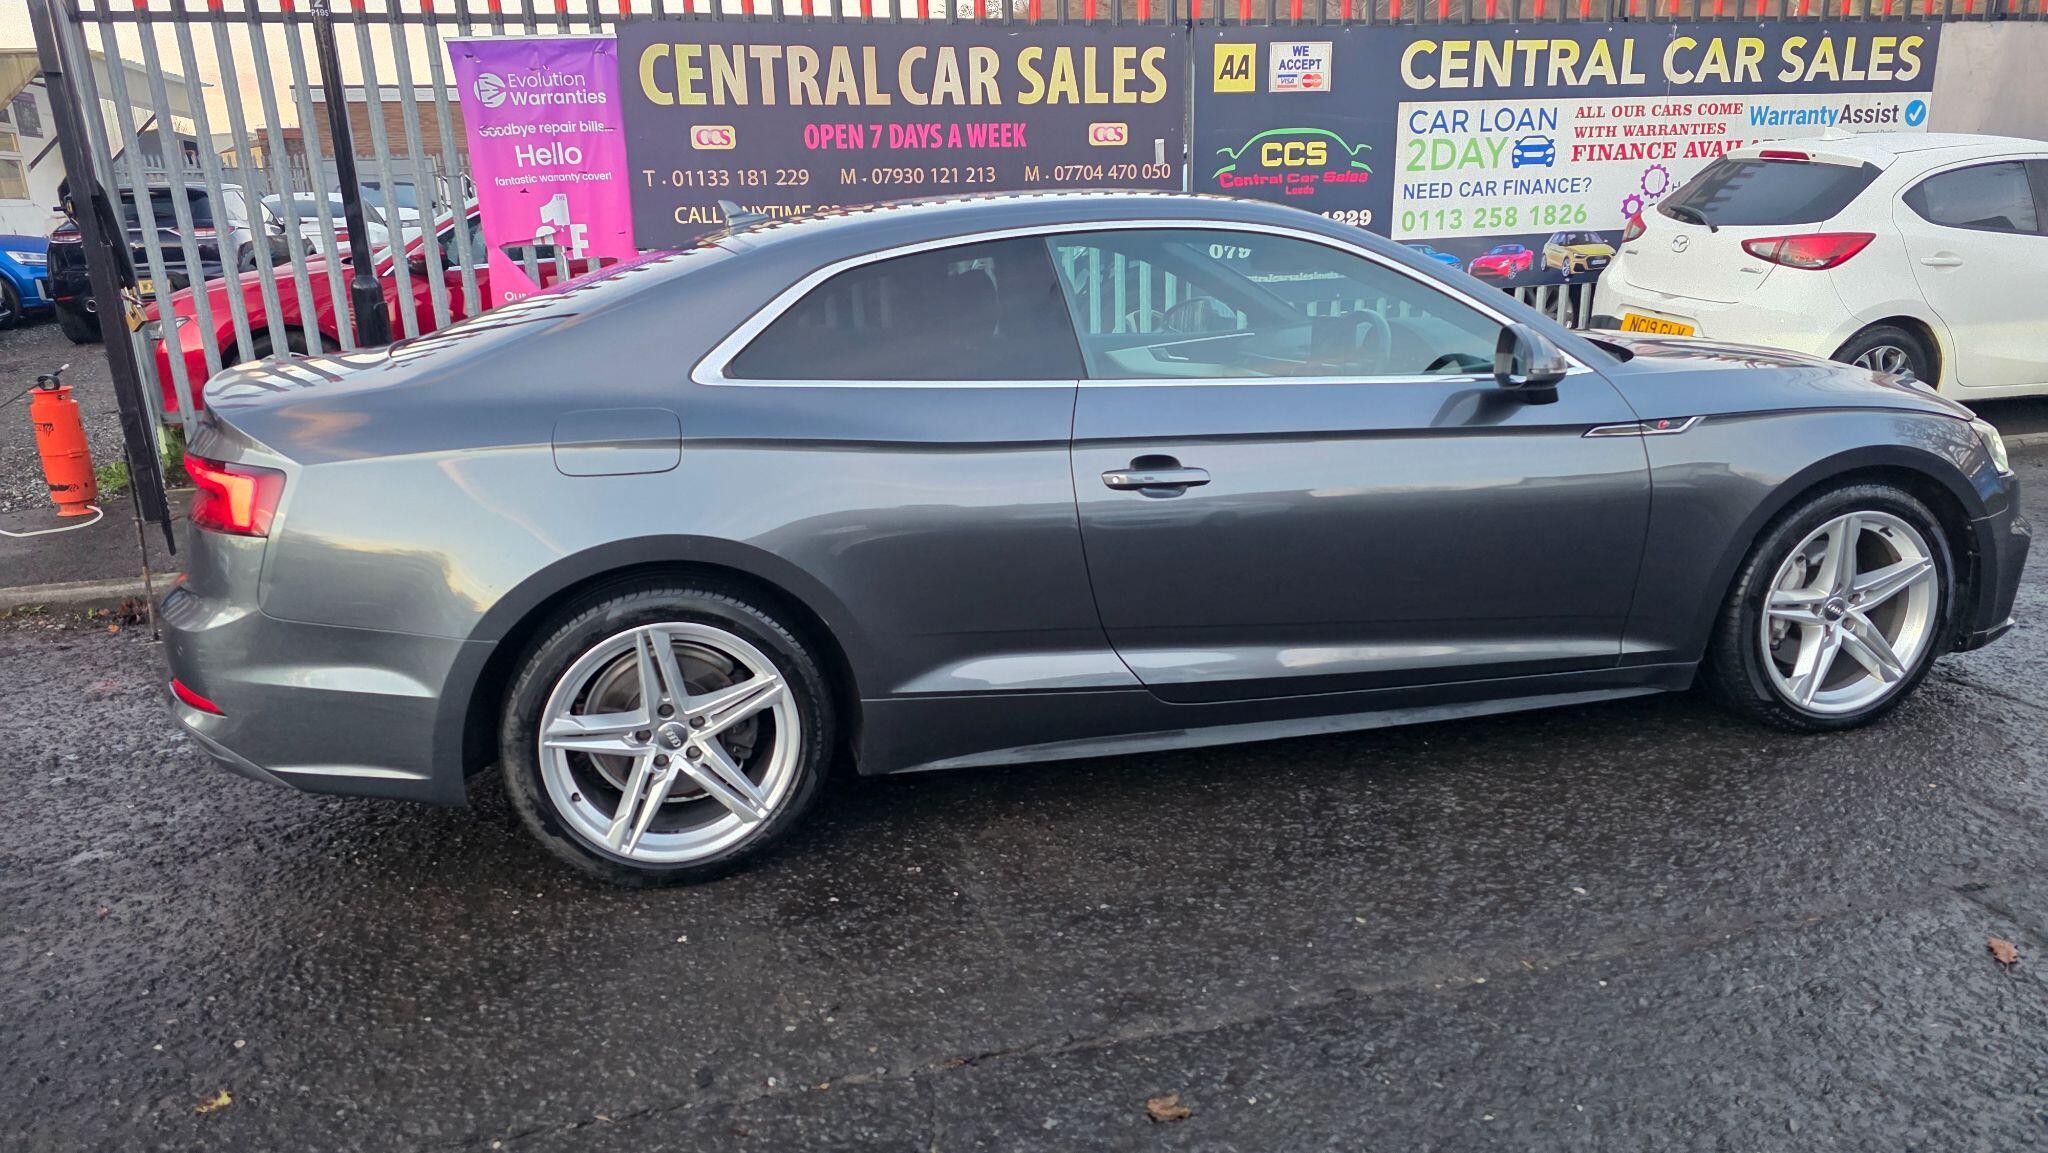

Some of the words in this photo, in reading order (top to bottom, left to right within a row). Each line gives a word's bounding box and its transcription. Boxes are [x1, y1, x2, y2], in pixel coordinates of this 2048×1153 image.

[1292, 46, 1309, 56] WE
[1218, 54, 1250, 80] AA
[1278, 59, 1322, 70] ACCEPT
[1400, 38, 1646, 90] CENTRAL
[1663, 36, 1765, 85] CAR
[1777, 35, 1924, 83] SALES
[507, 72, 586, 88] Evolution
[638, 43, 891, 106] CENTRAL
[898, 46, 1002, 106] CAR
[1017, 46, 1168, 105] SALES
[510, 89, 607, 106] Warranties
[1409, 109, 1469, 134] CAR
[1480, 107, 1558, 132] LOAN
[1575, 105, 1606, 119] ALL
[1611, 104, 1646, 118] OUR
[1652, 104, 1692, 117] CARS
[1697, 103, 1743, 115] COME
[539, 121, 576, 136] repair
[804, 124, 864, 149] OPEN
[870, 124, 883, 149] 7
[889, 124, 942, 149] DAYS
[948, 124, 962, 149] A
[966, 122, 1027, 148] WEEK
[1574, 125, 1617, 138] WITH
[1622, 123, 1726, 137] WARRANTIES
[515, 142, 582, 167] Hello
[1261, 141, 1327, 167] CCS
[1406, 136, 1509, 171] 2DAY
[1571, 142, 1677, 163] FINANCE
[495, 174, 538, 186] fantastic
[539, 173, 580, 183] warranty
[671, 169, 730, 187] 01133
[737, 169, 768, 186] 181
[775, 169, 809, 186] 229
[872, 167, 924, 185] 07930
[930, 168, 958, 183] 121
[966, 167, 996, 183] 213
[1054, 165, 1103, 181] 07704
[1108, 164, 1137, 180] 470
[1142, 163, 1171, 179] 050
[1219, 172, 1283, 188] Central
[1287, 173, 1319, 183] Car
[1323, 171, 1369, 183] Sales
[1285, 185, 1315, 195] Leeds
[1403, 183, 1452, 199] NEED
[1459, 180, 1497, 198] CAR
[1503, 177, 1592, 196] FINANCE?
[674, 207, 724, 224] CALL
[1401, 209, 1463, 232] 0113
[1473, 206, 1518, 229] 258
[1530, 204, 1587, 226] 1826
